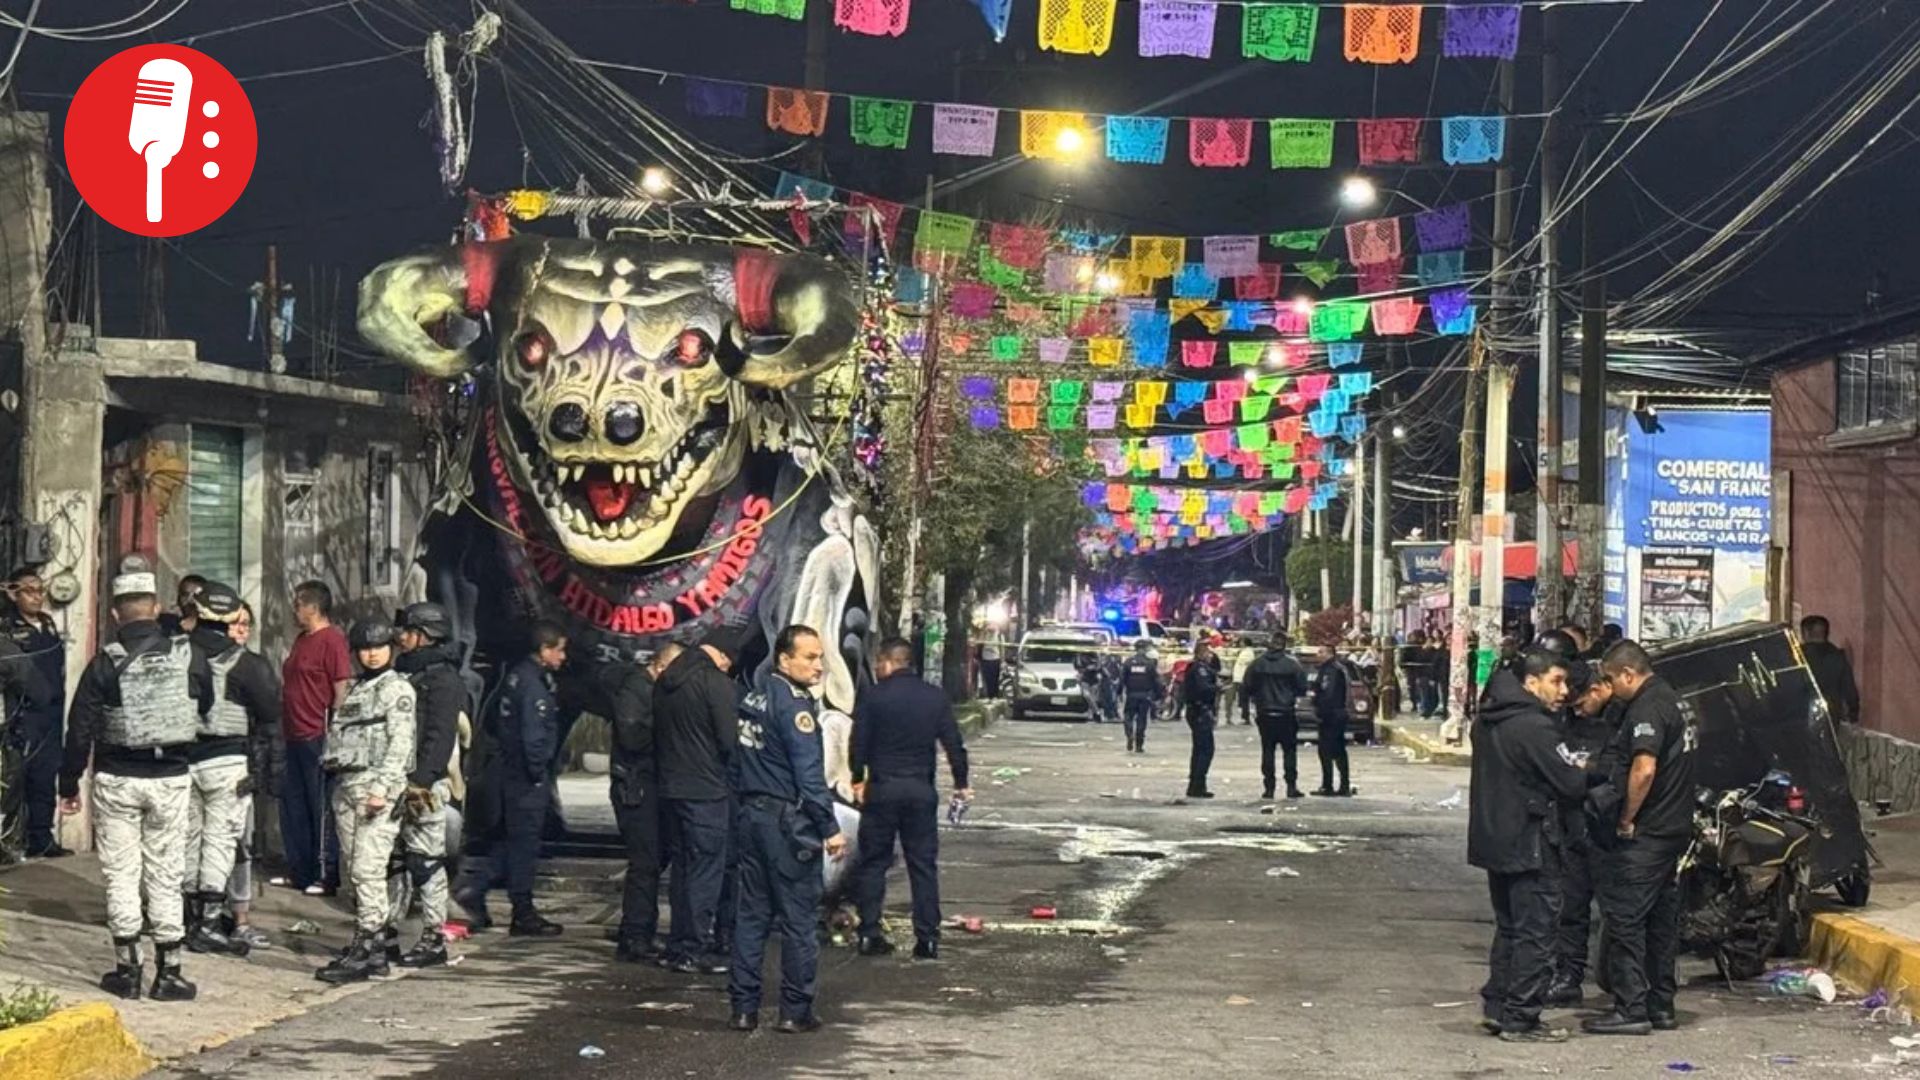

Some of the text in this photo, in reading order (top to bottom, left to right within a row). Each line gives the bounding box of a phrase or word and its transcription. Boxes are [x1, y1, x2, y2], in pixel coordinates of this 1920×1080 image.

[1657, 460, 1771, 479] COMERCIAL
[1720, 481, 1771, 496] FRANC
[1650, 500, 1726, 517] PRODUCTOS
[1698, 518, 1762, 530] CUBETAS
[1653, 531, 1770, 544] BANCOS JARRA
